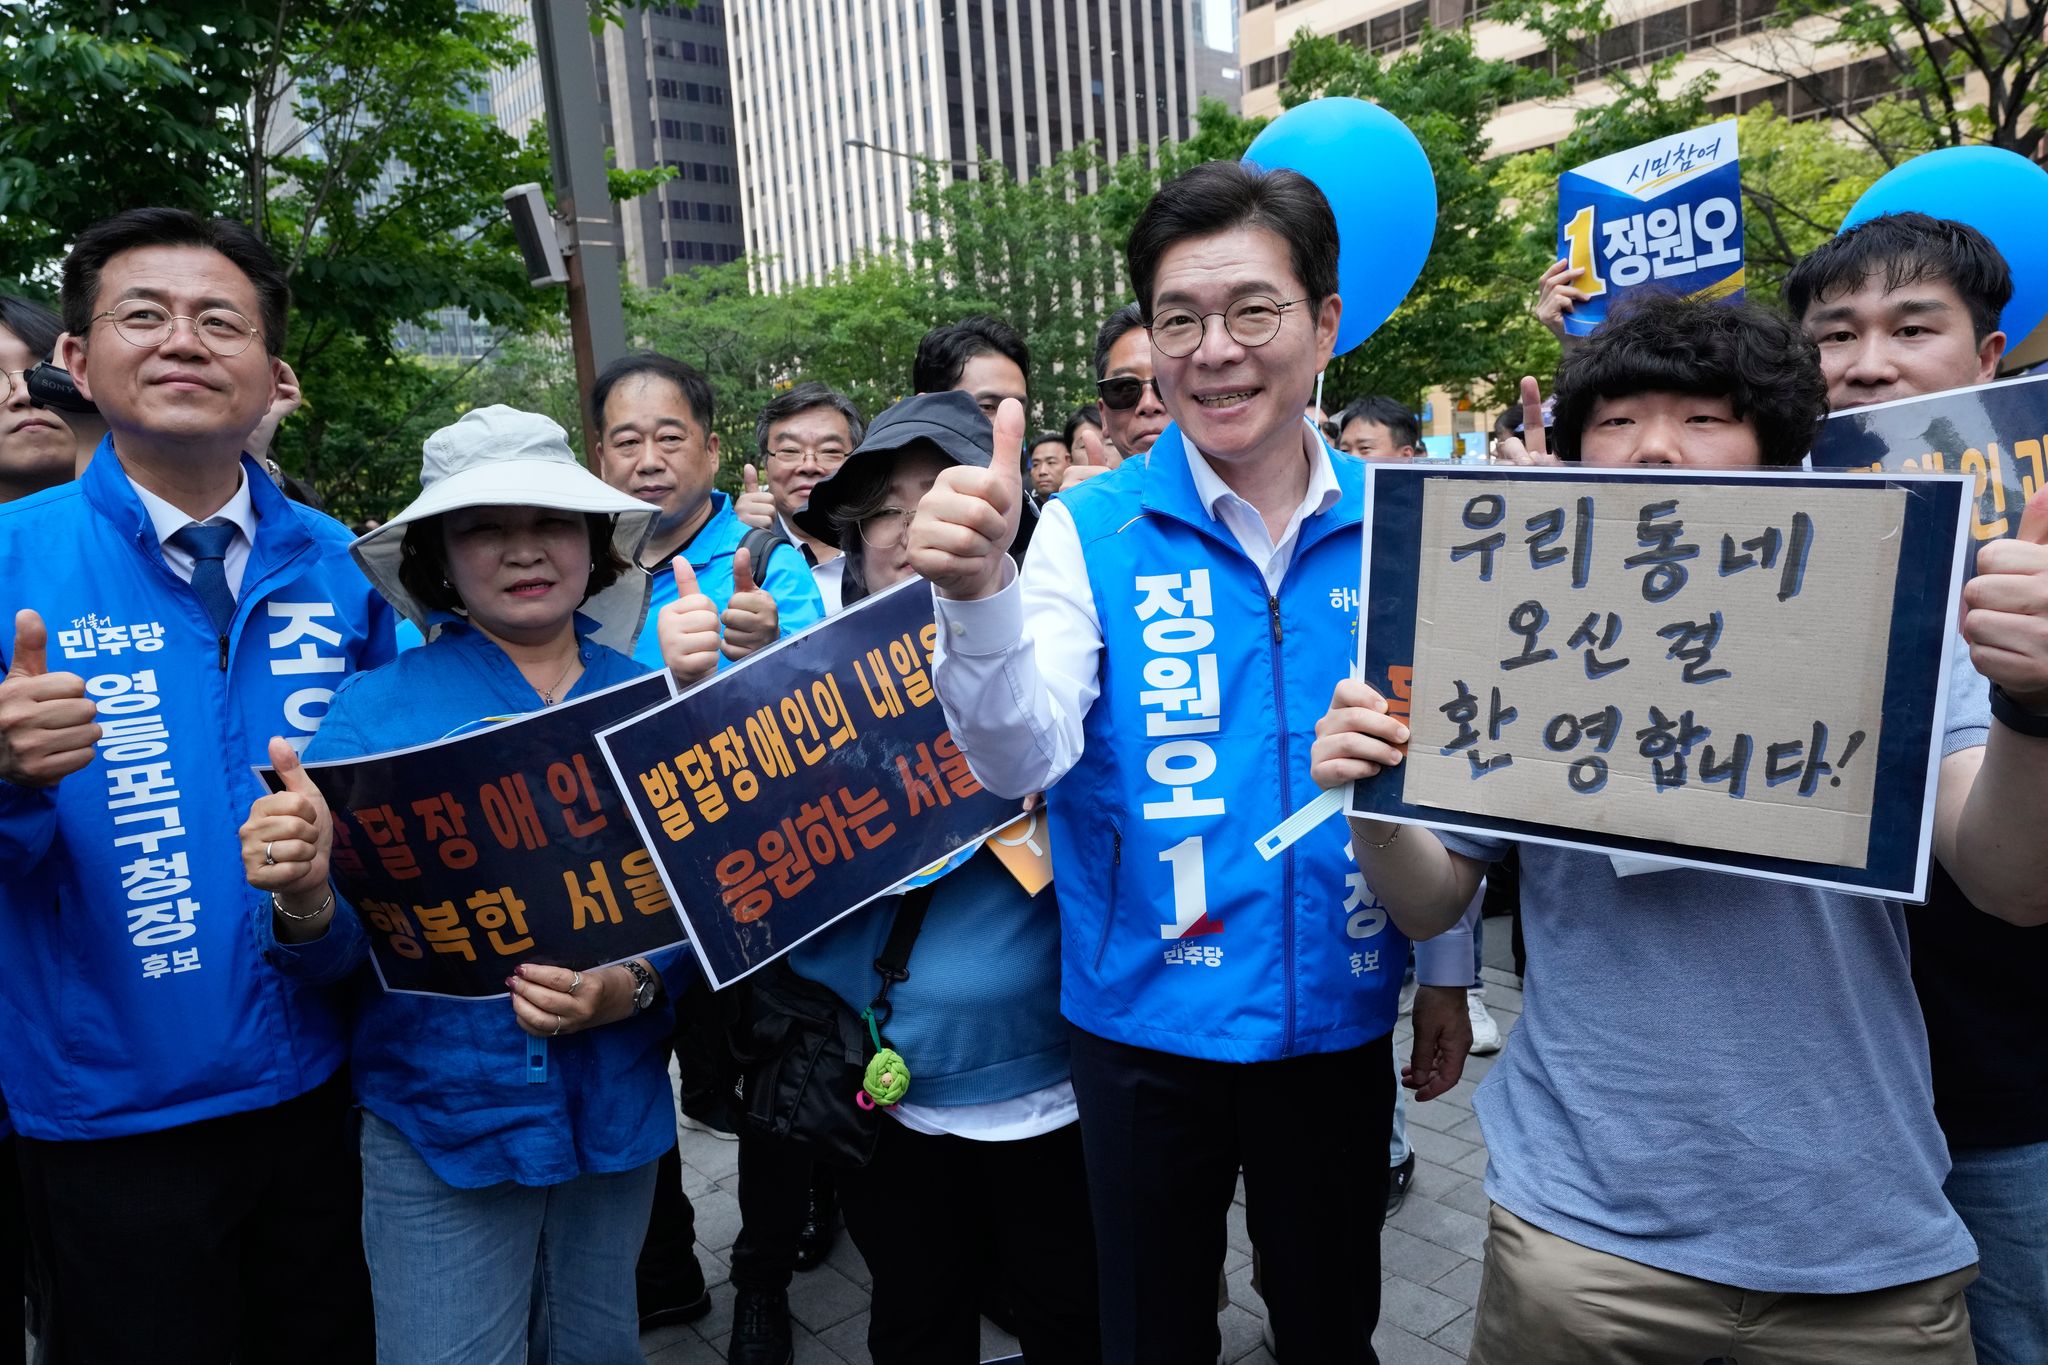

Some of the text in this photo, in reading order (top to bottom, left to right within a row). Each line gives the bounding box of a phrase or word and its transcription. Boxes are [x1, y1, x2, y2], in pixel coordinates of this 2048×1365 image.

[1626, 137, 1721, 184] 시민참여
[1564, 205, 1607, 297] 1
[1602, 197, 1741, 287] 정원오
[41, 378, 74, 394] SONY
[1451, 493, 1814, 603] 우리 동네
[57, 621, 166, 660] 민주당
[71, 612, 111, 630] 더불어
[1500, 600, 1732, 685] 오신 걸
[1133, 568, 1227, 821] 정원오
[639, 672, 858, 842] 발달장애인의
[85, 669, 201, 947] 영등포구청장
[714, 786, 897, 924] 응원하는
[1158, 836, 1225, 941] 1
[359, 849, 675, 962] 행복한 서울
[141, 946, 202, 979] 후보
[1163, 946, 1225, 968] 민주당
[1348, 949, 1380, 978] 후보
